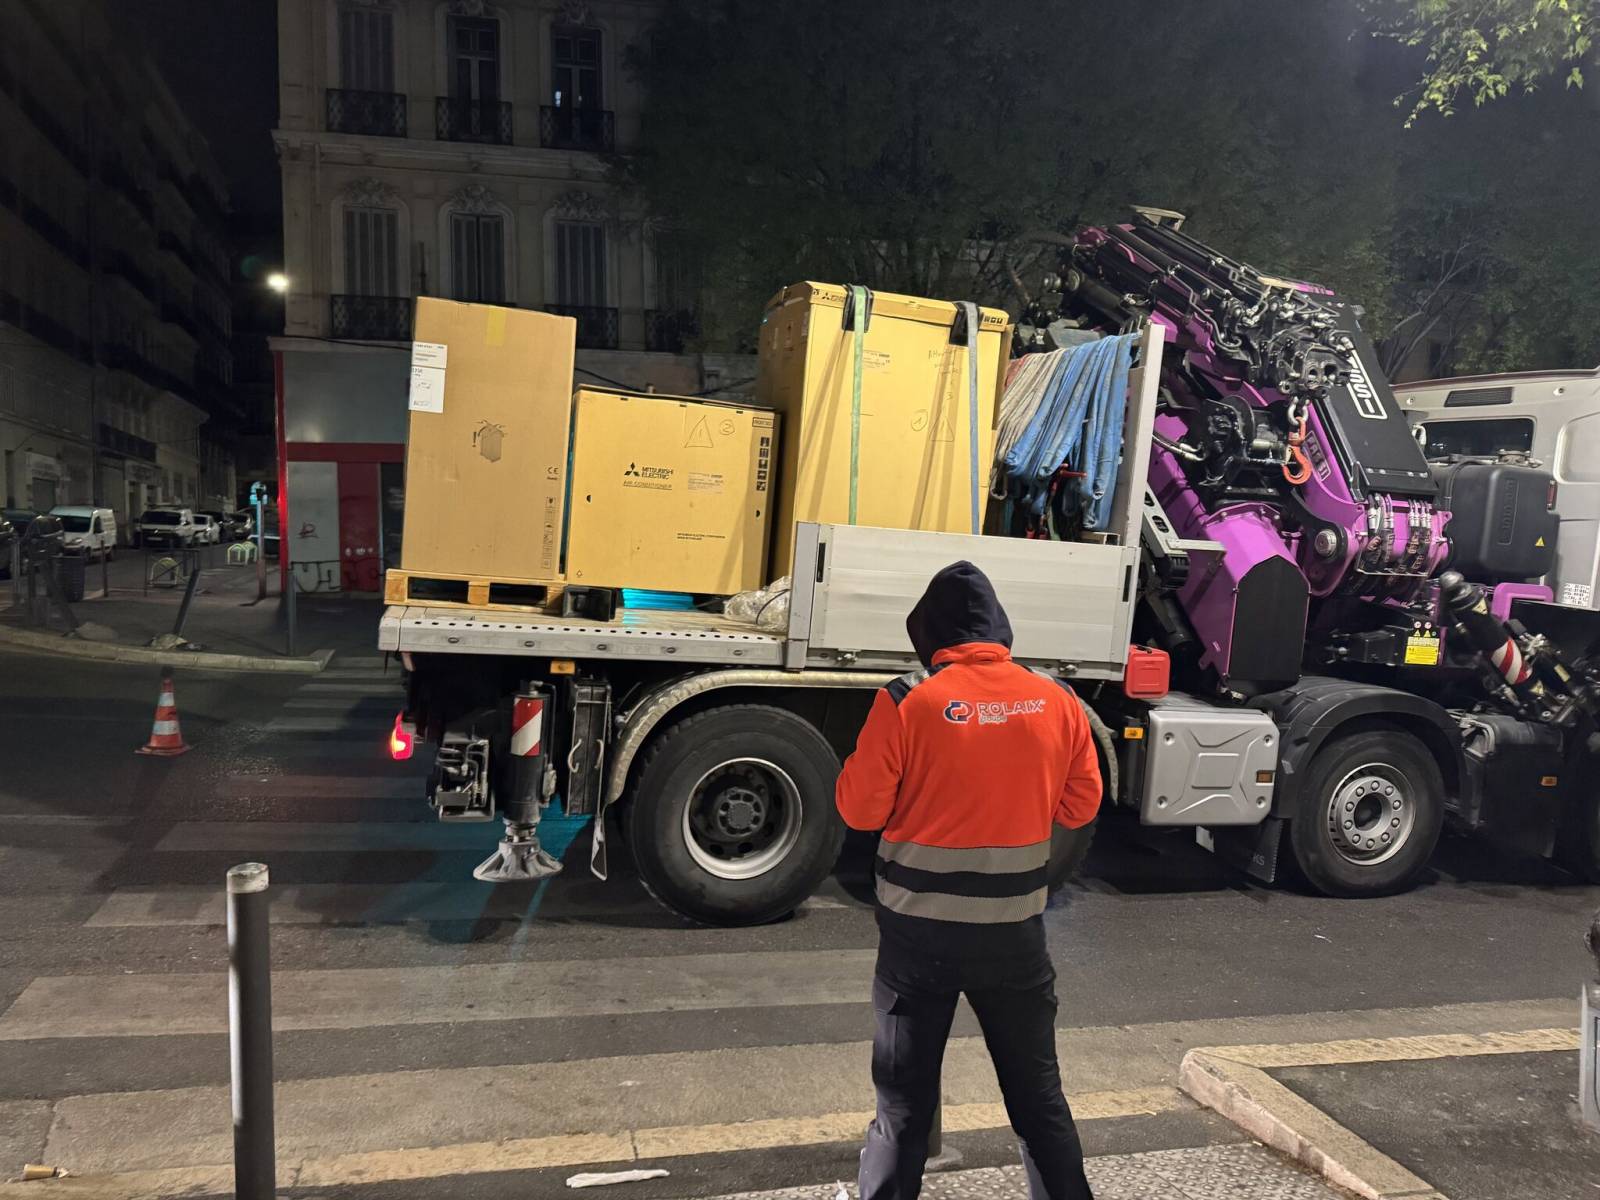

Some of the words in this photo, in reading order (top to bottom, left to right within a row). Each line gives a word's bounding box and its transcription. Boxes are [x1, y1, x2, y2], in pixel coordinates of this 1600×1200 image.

[641, 467, 674, 475] MITSUBISHI
[641, 472, 670, 480] ELECTRIC
[976, 700, 1044, 716] ROLAIX
